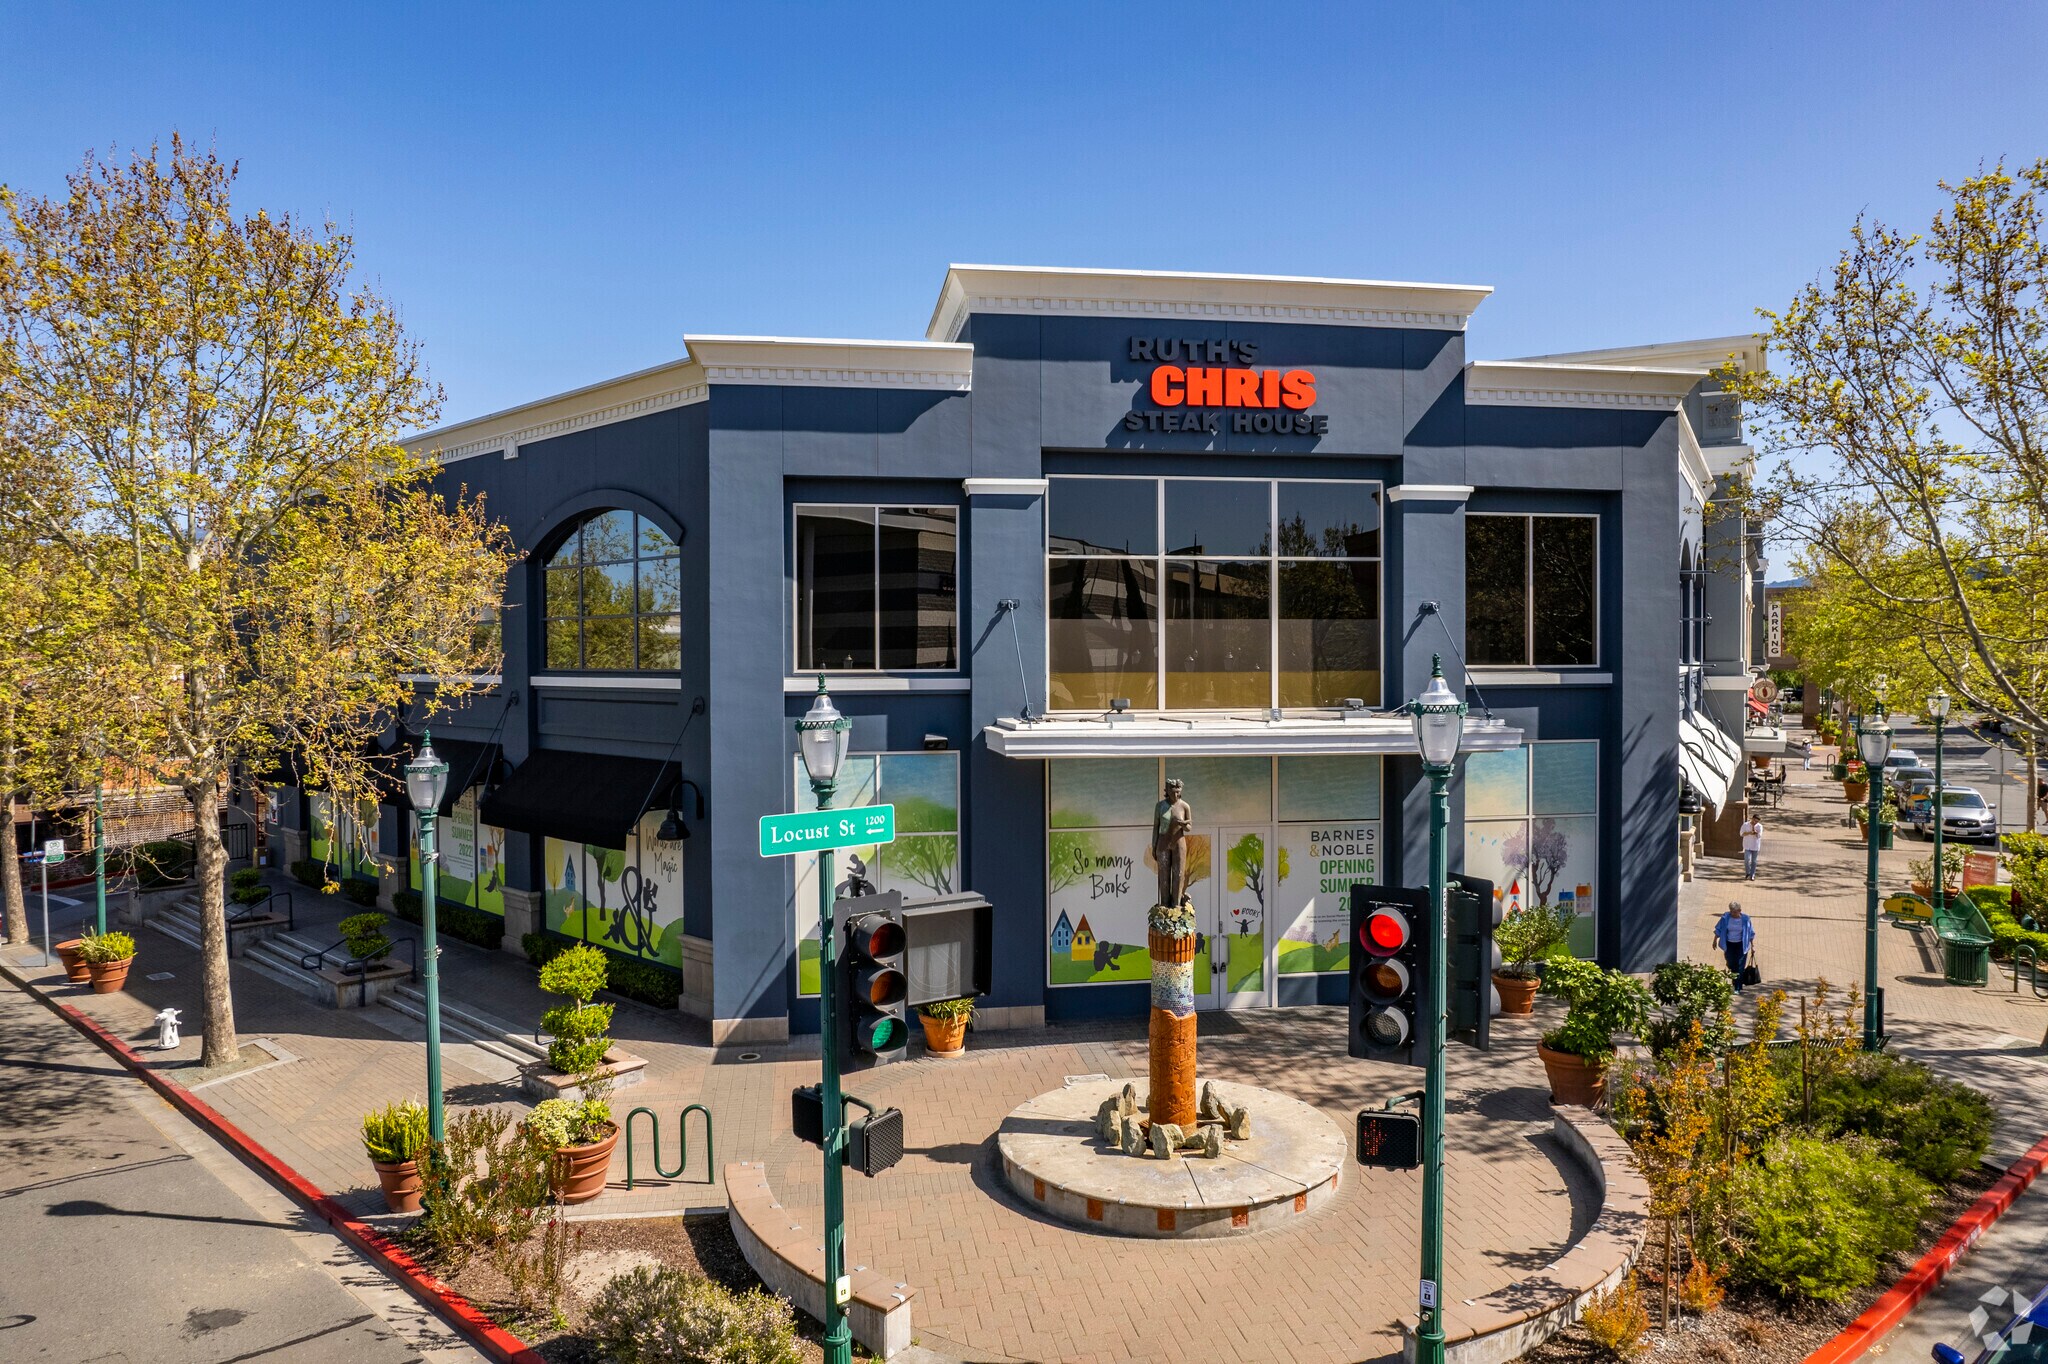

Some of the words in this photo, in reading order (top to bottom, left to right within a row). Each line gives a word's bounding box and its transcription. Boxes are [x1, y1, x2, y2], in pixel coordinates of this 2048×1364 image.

[1130, 336, 1259, 364] RUTH'S
[1150, 365, 1317, 409] CHRIS
[1125, 410, 1221, 432] STEAK
[1233, 413, 1329, 434] HOUSE
[1771, 604, 1779, 654] PARKING
[770, 824, 830, 844] Locust
[839, 819, 856, 837] St
[865, 815, 885, 826] 1200
[1311, 829, 1374, 842] BARNES
[654, 851, 679, 883] Magic
[1072, 847, 1089, 875] So
[1096, 854, 1133, 880] many
[1319, 858, 1374, 875] OPENING
[1089, 873, 1131, 900] Books
[1241, 908, 1260, 918] BOOKS
